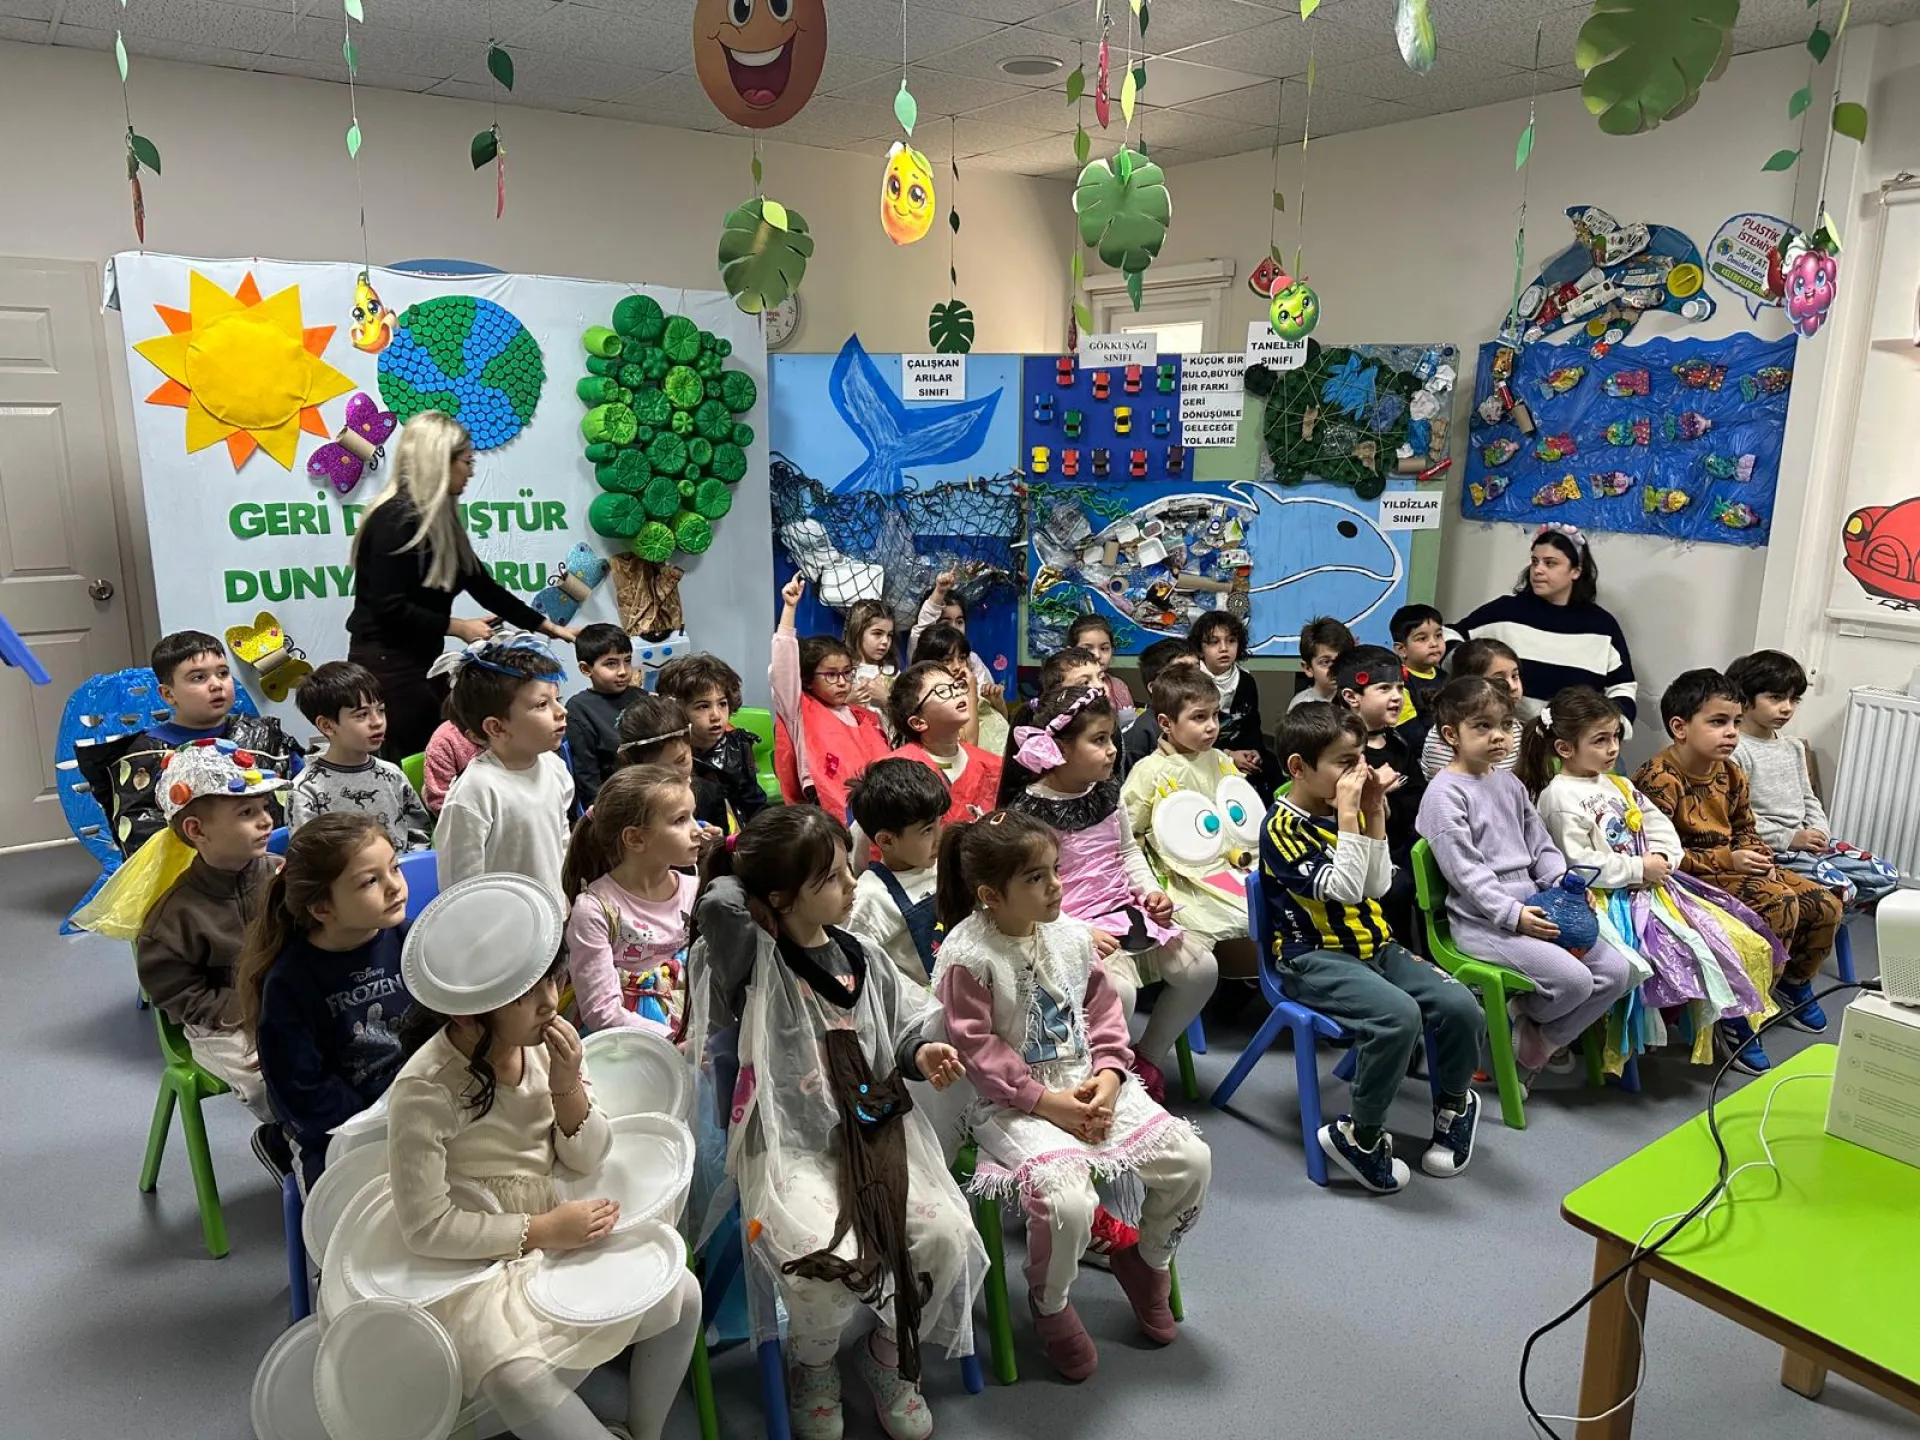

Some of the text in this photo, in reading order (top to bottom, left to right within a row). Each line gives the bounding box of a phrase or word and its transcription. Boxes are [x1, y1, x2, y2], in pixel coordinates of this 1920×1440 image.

[1743, 218, 1780, 242] PLASTİK
[1738, 230, 1772, 253] İSTEMİY
[1089, 340, 1147, 351] GÖKKUŞAĞI
[1227, 355, 1244, 364] BİR
[1261, 356, 1293, 364] SINIFI
[907, 360, 960, 369] ÇALIŞKAN
[915, 374, 953, 382] ARILAR
[1182, 383, 1198, 391] BİR
[918, 389, 949, 397] SINIFI
[1182, 397, 1206, 406] GERİ
[1182, 409, 1242, 419] DÖNÜŞÜMLE
[1184, 422, 1234, 432] GELECEĞE
[229, 491, 331, 539] GERİ
[1392, 515, 1425, 523] SINIFI
[224, 565, 356, 603] DUNY
[325, 974, 404, 1018] FROZEN
